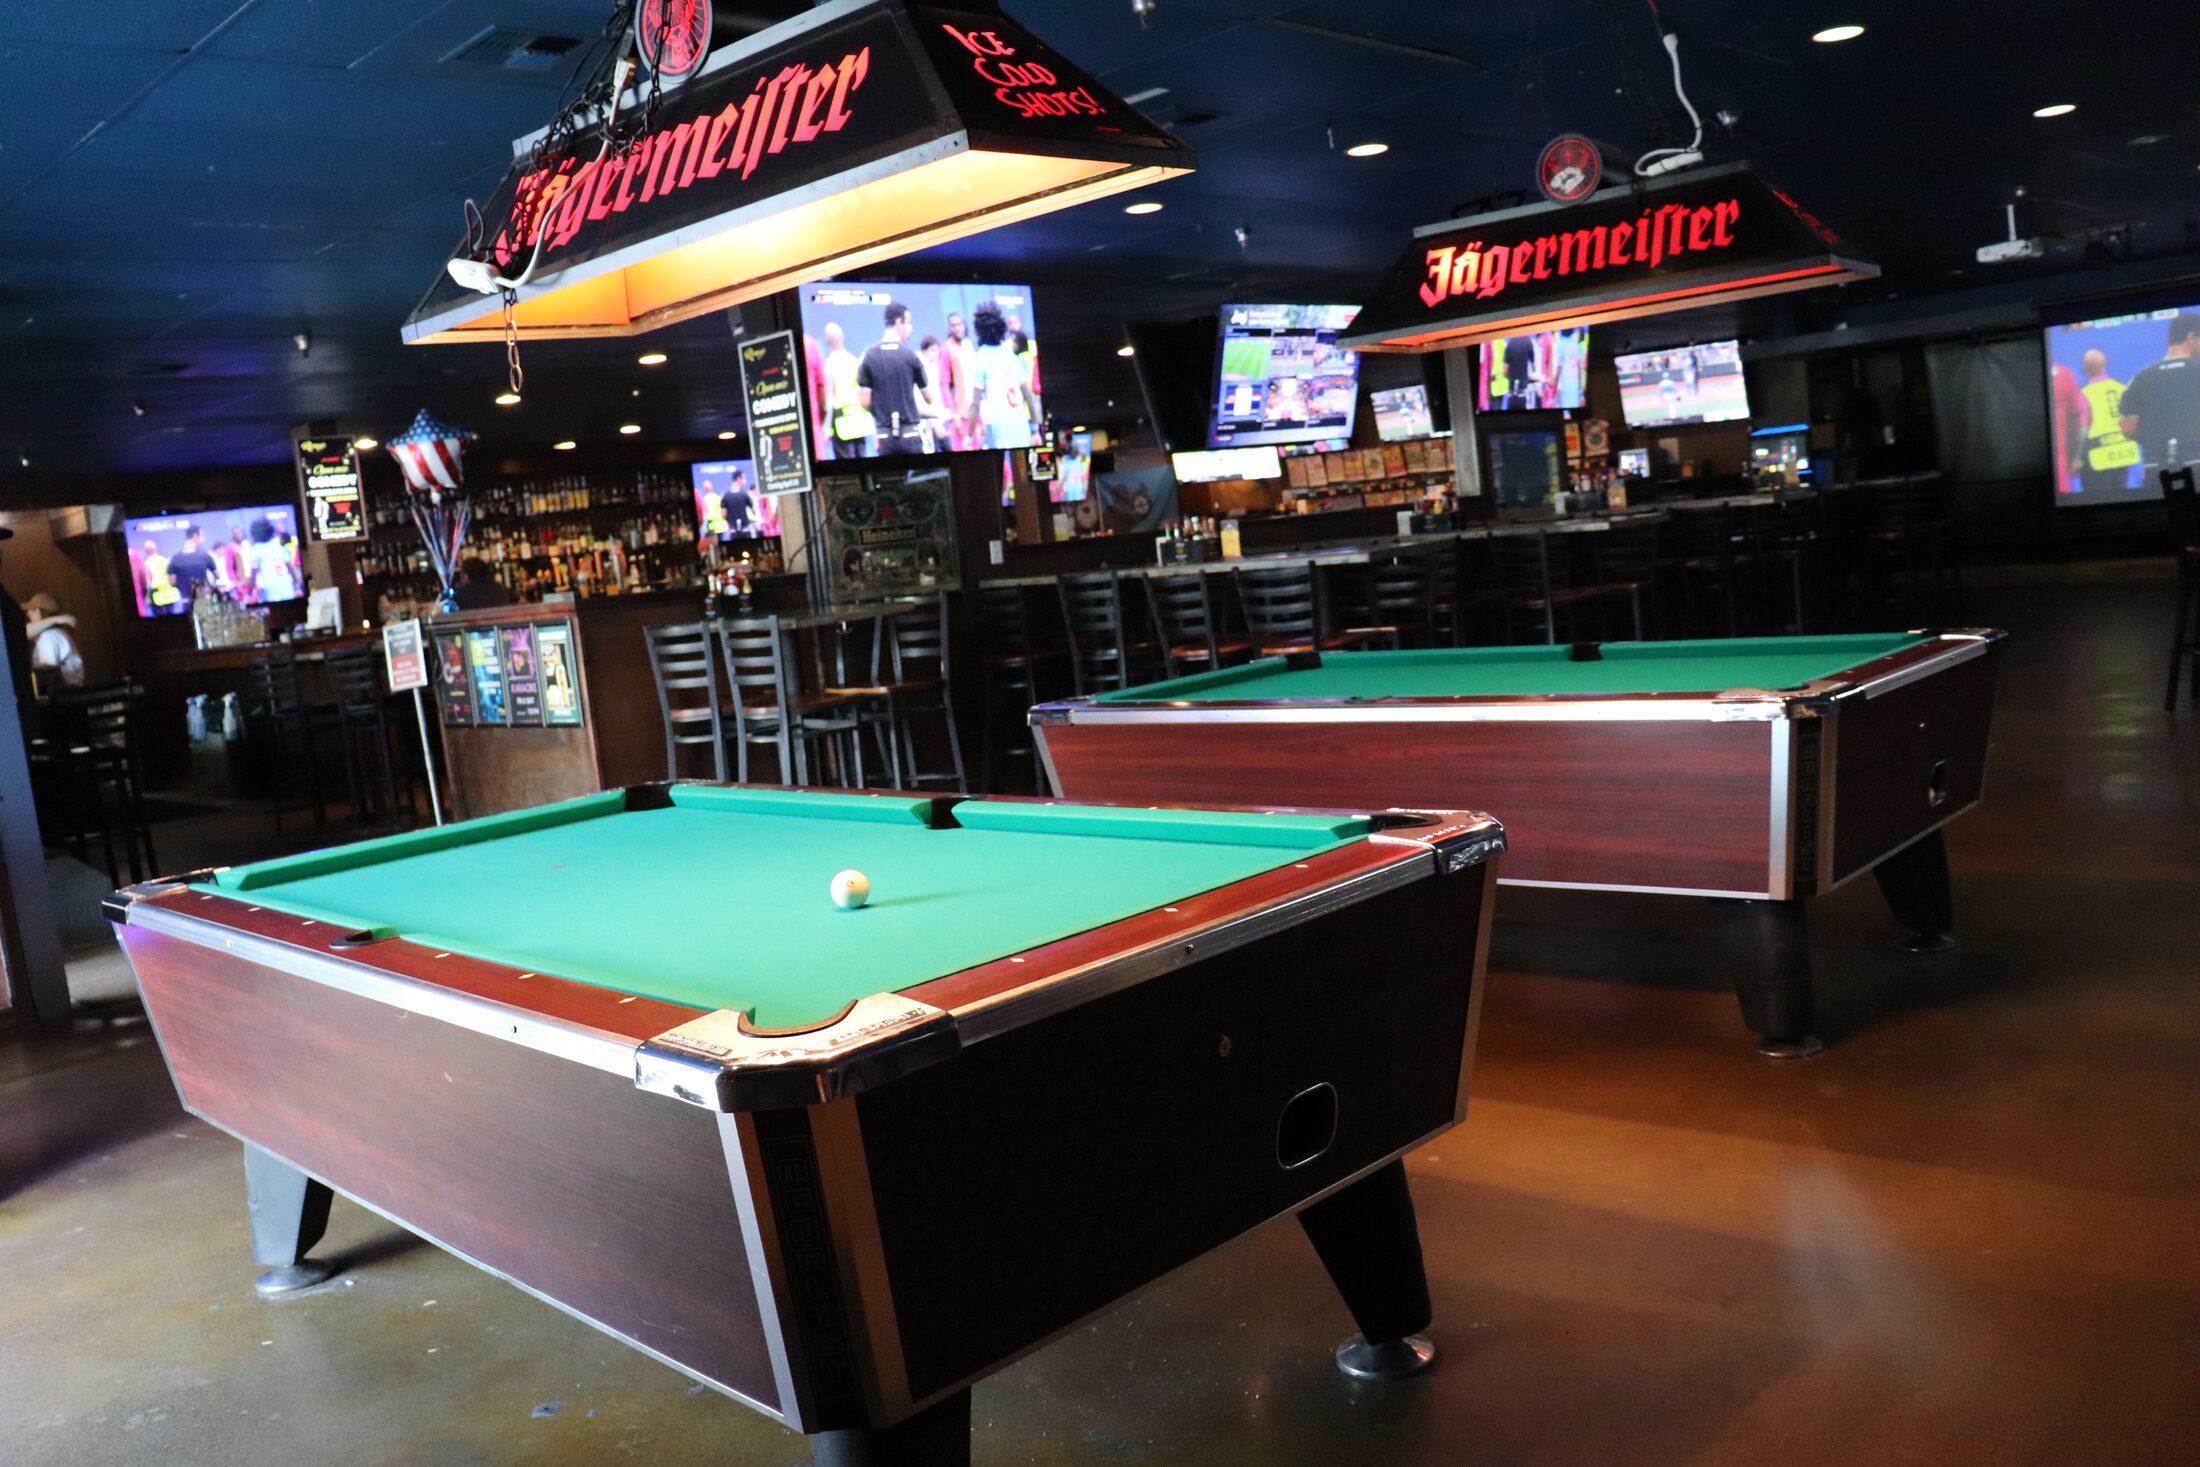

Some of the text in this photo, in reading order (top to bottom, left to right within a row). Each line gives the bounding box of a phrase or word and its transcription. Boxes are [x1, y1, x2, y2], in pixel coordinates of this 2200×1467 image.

[942, 24, 1015, 56] ICE
[974, 57, 1057, 87] COLD
[994, 86, 1106, 118] SHOTS!
[752, 391, 796, 415] COMEDY
